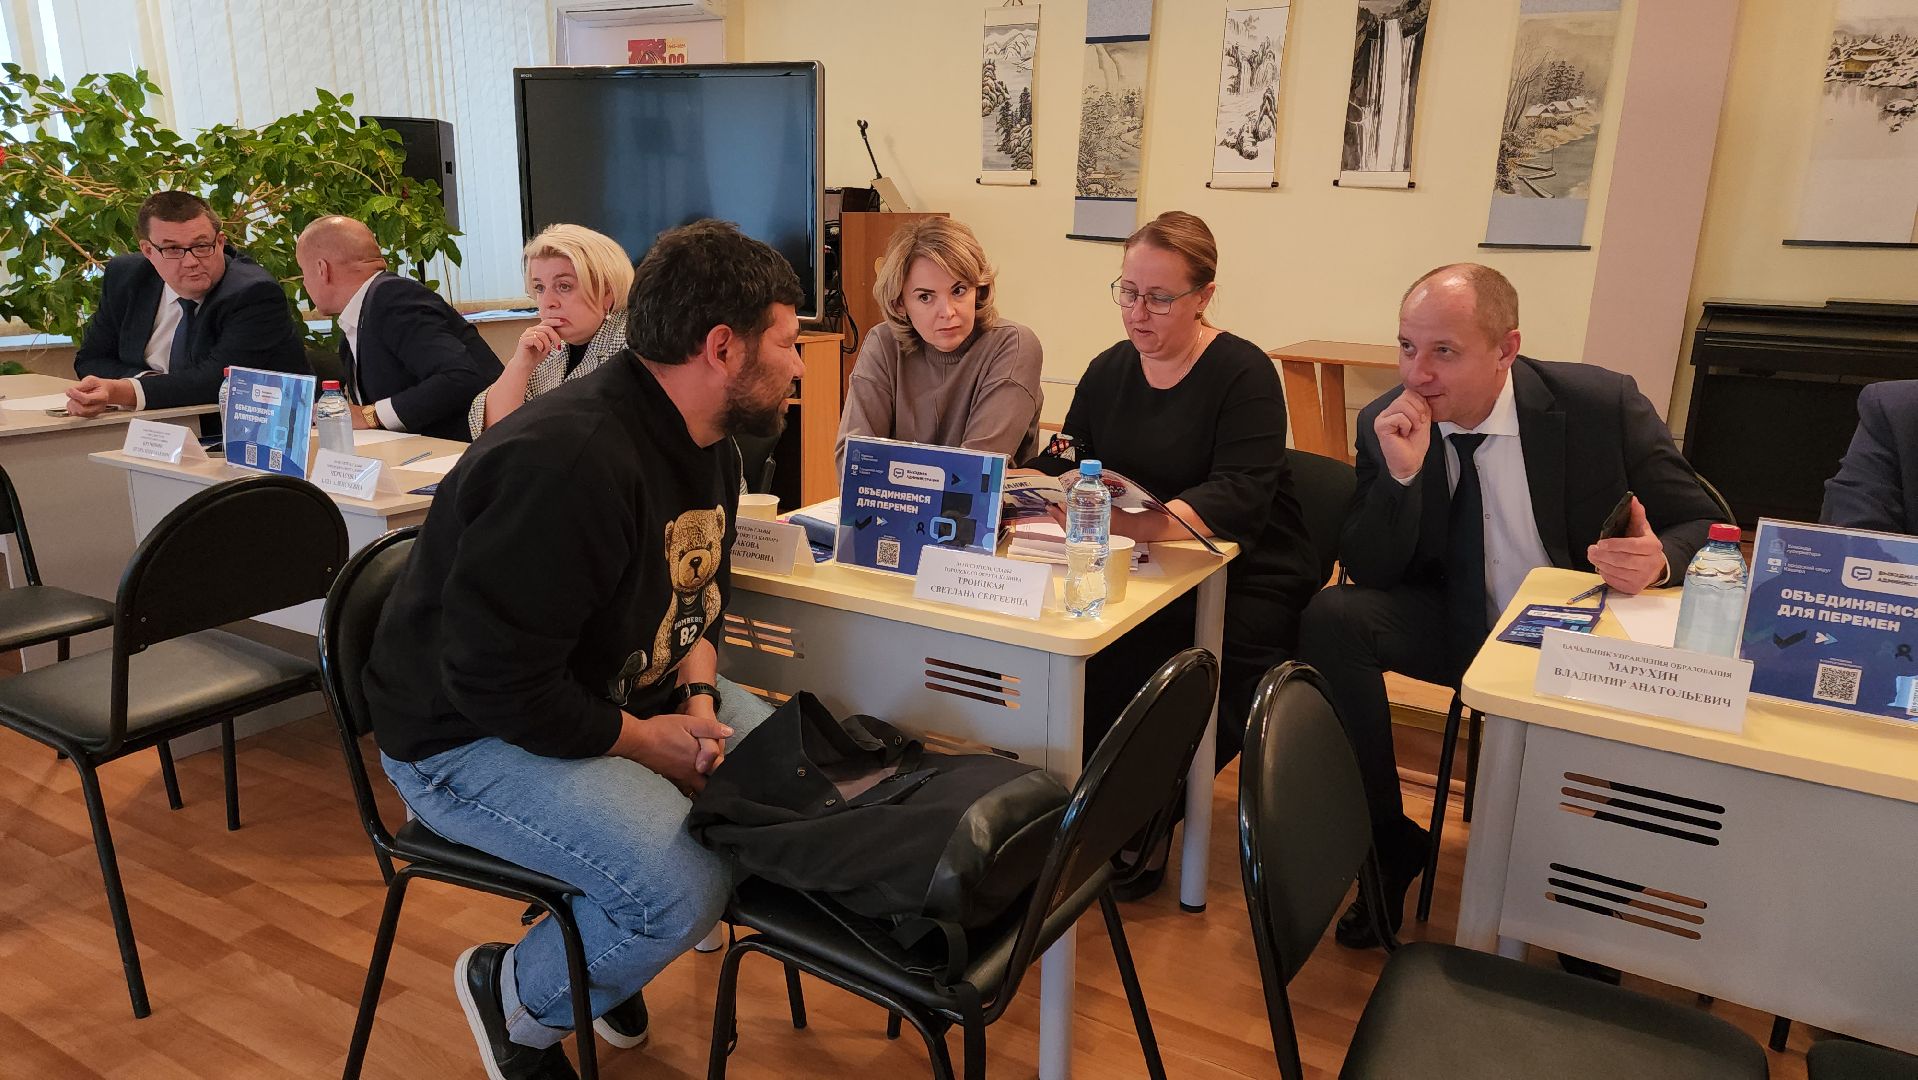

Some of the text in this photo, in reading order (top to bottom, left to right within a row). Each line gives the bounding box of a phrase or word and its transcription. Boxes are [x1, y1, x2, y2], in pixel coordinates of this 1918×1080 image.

[858, 486, 932, 504] ОБЪЕДИНЯЕМСЯ
[856, 498, 919, 514] ДЛЯ ПЕРЕМЕН
[736, 540, 760, 550] АКОВА
[1777, 604, 1900, 632] ДЛЯ ПЕРЕМЕН
[680, 624, 698, 646] 82
[1562, 643, 1612, 658] НАЧАЛЬНИК
[1670, 662, 1732, 679] ОБРАЗОВАНИЯ
[1608, 662, 1680, 682] МАРУХИН
[1554, 667, 1732, 708] ВЛАДИМИР АНАТОЛЬЕВИЧ
